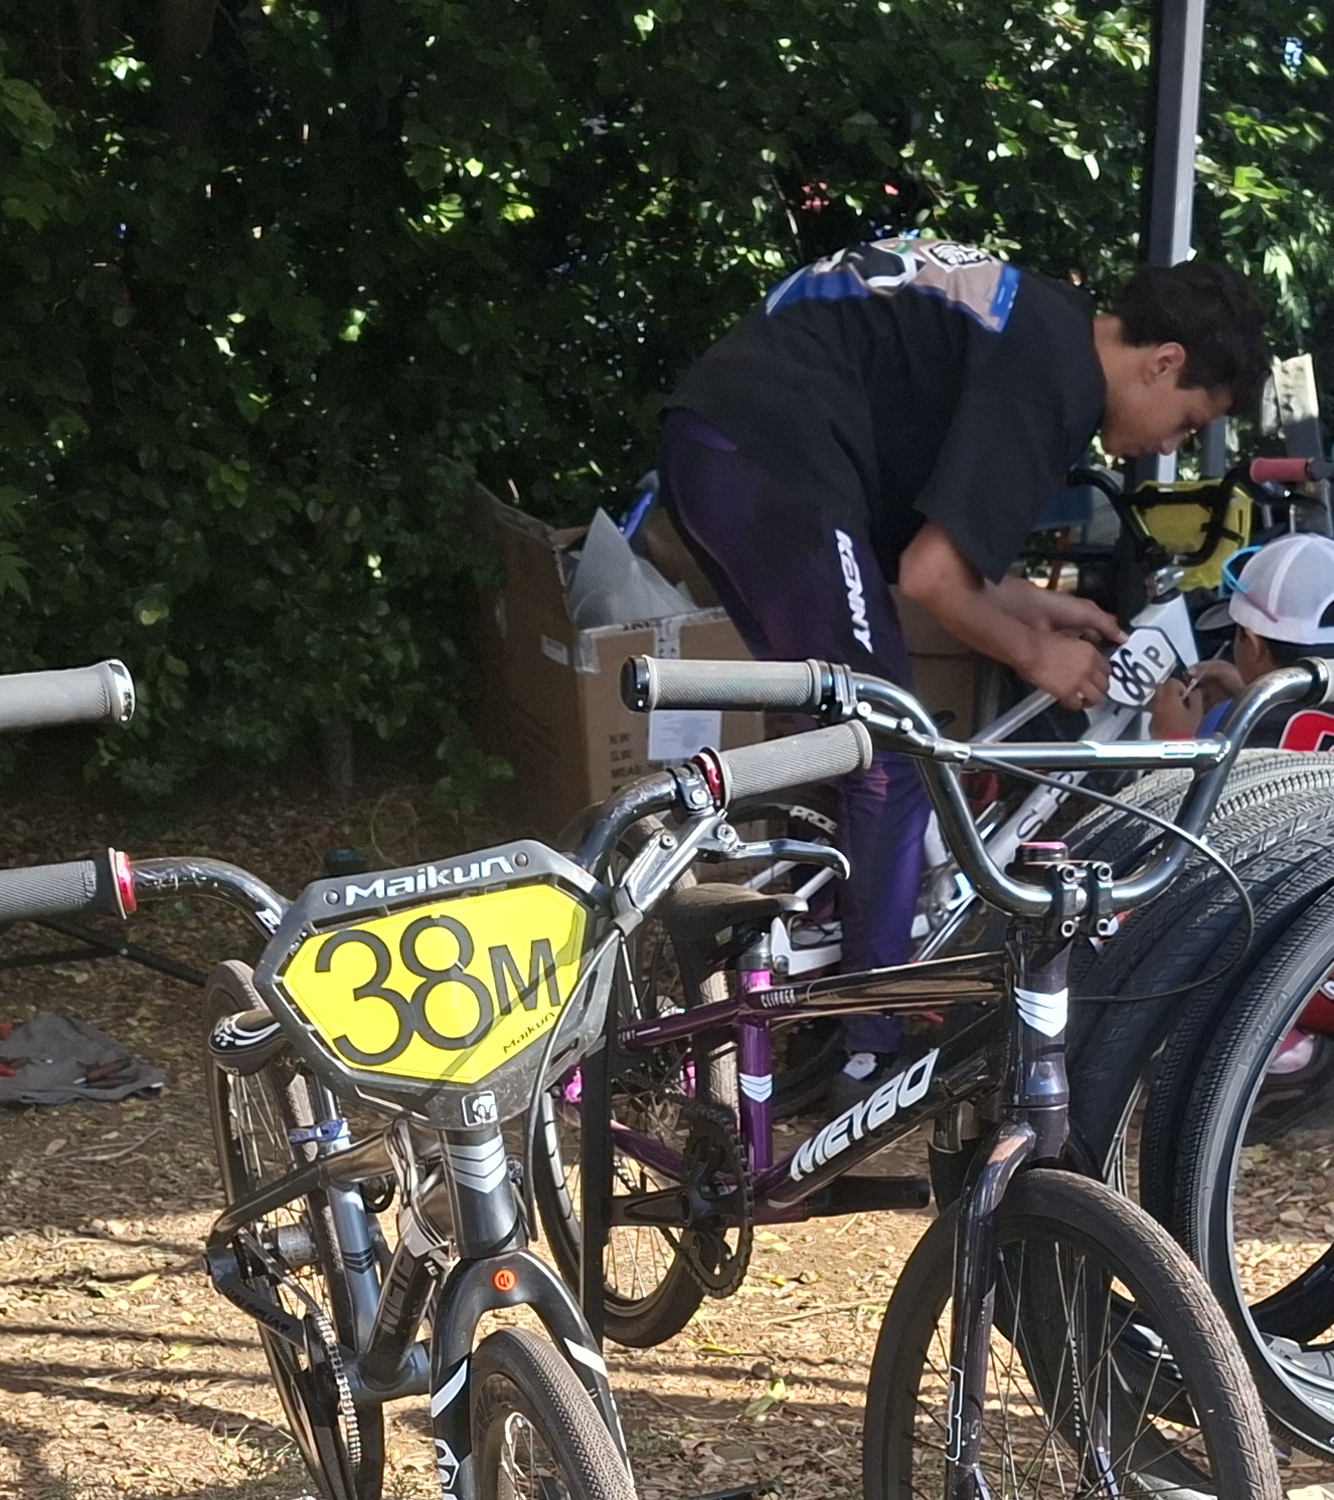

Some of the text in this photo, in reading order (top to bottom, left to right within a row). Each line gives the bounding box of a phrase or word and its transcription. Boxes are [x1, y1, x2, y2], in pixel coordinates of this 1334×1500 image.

[834, 528, 874, 654] KENNY
[345, 854, 514, 906] Maikun
[503, 1011, 556, 1054] Maikun
[789, 1046, 941, 1182] MEYBO
